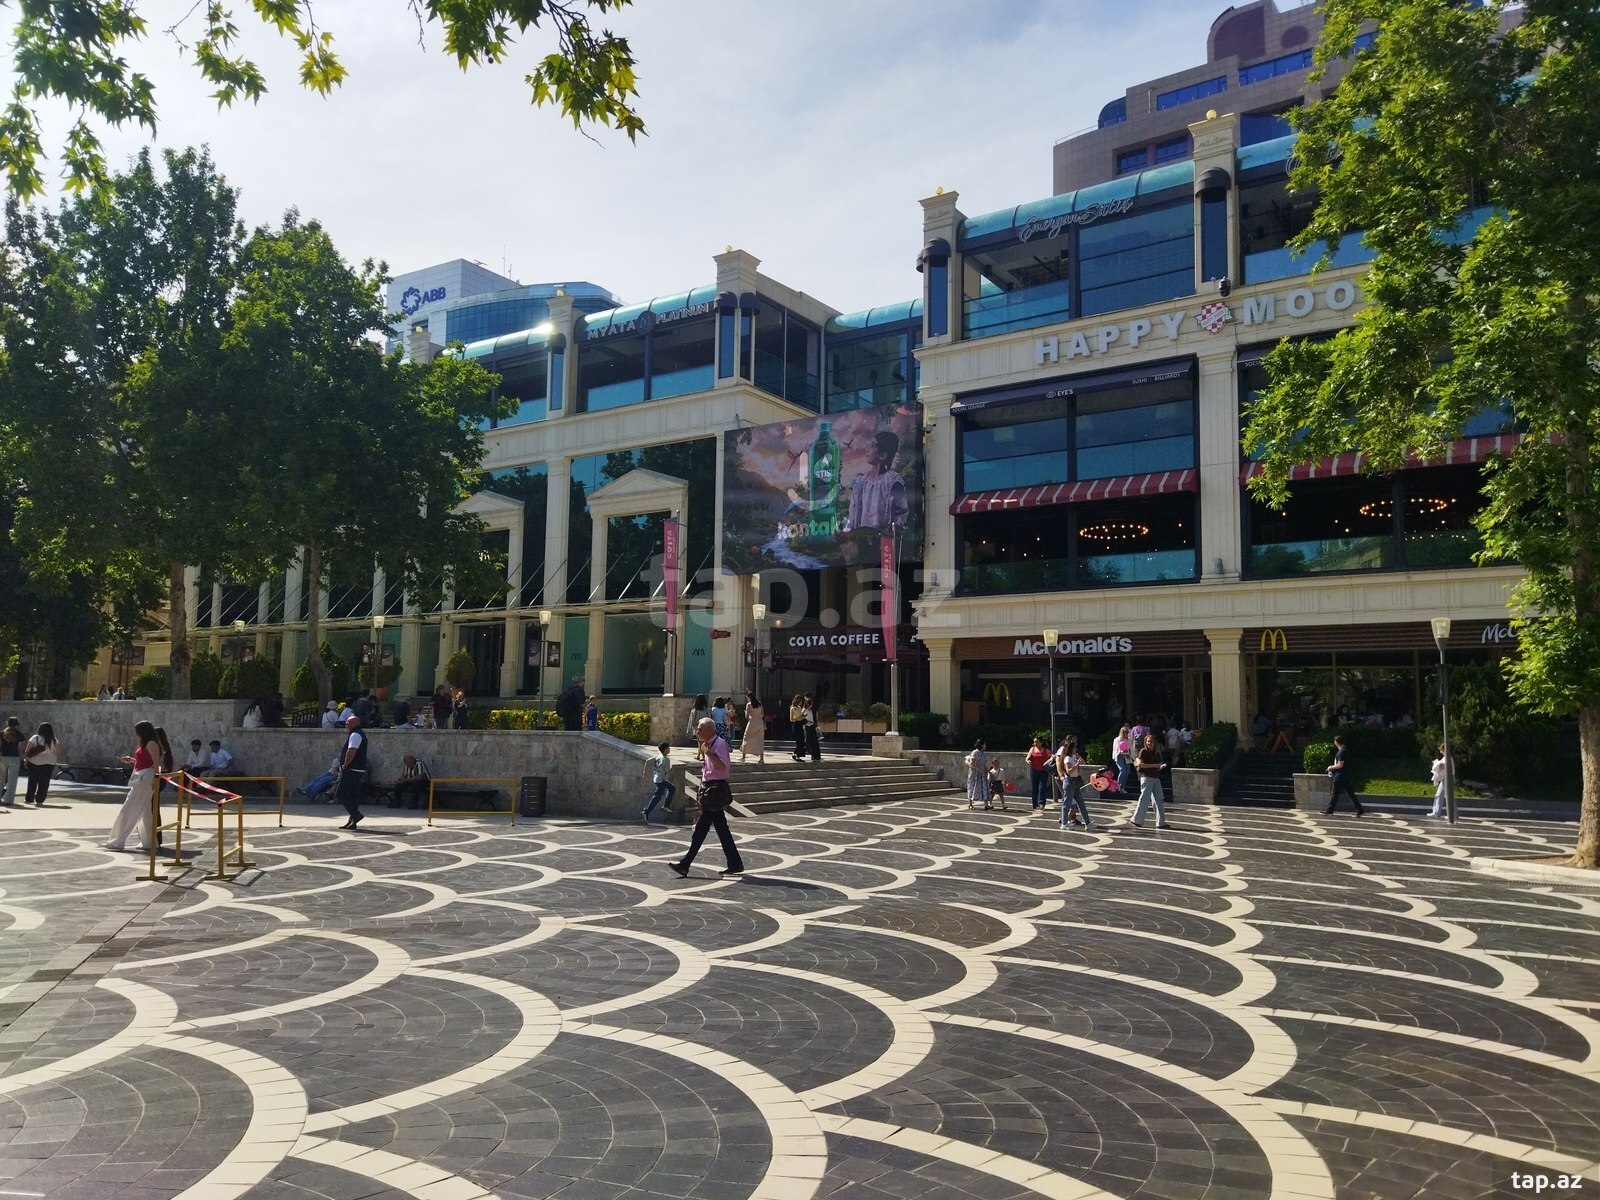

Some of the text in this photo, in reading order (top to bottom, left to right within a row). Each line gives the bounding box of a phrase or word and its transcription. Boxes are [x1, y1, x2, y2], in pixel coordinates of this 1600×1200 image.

[421, 286, 447, 304] ABB
[586, 320, 636, 340] MYATA
[654, 302, 710, 325] PLATINUM
[1035, 280, 1356, 365] HAPPY MOO
[1131, 372, 1181, 385] SUSHI BILLIARDS
[1057, 388, 1074, 397] EYE'S
[666, 529, 674, 559] COSTA
[789, 633, 880, 648] COSTA COFFEE
